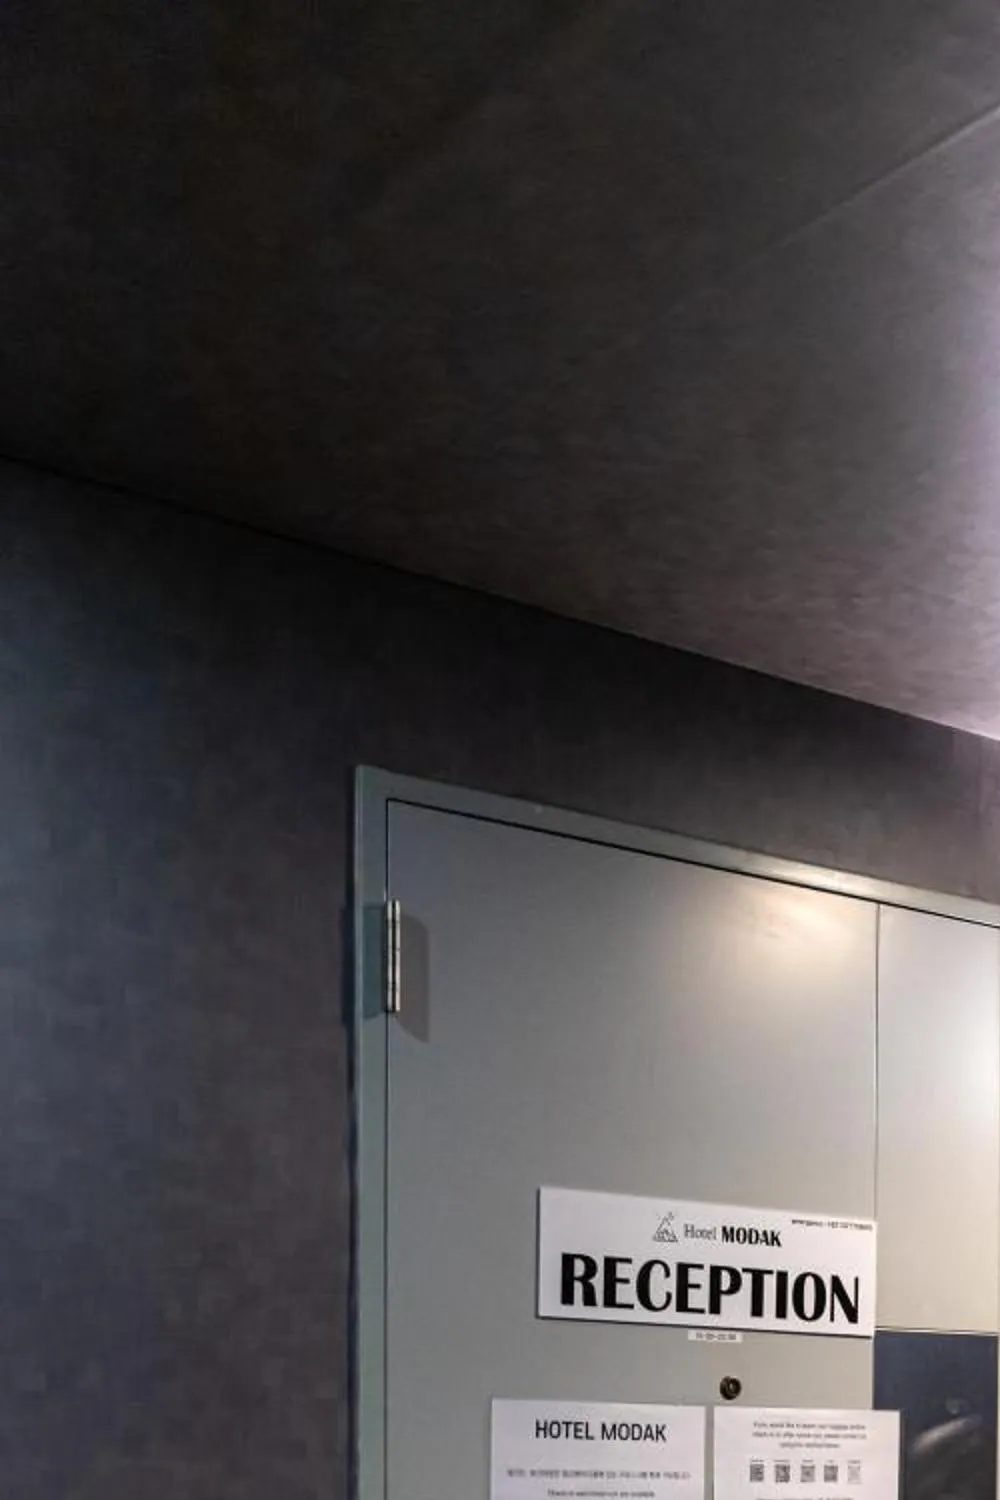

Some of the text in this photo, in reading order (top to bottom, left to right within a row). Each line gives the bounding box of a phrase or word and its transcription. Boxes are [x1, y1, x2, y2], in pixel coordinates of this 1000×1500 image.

[684, 1223, 782, 1247] Hotel MODAK
[561, 1252, 859, 1324] RECEPTION
[535, 1419, 667, 1443] HOTEL MODAK
